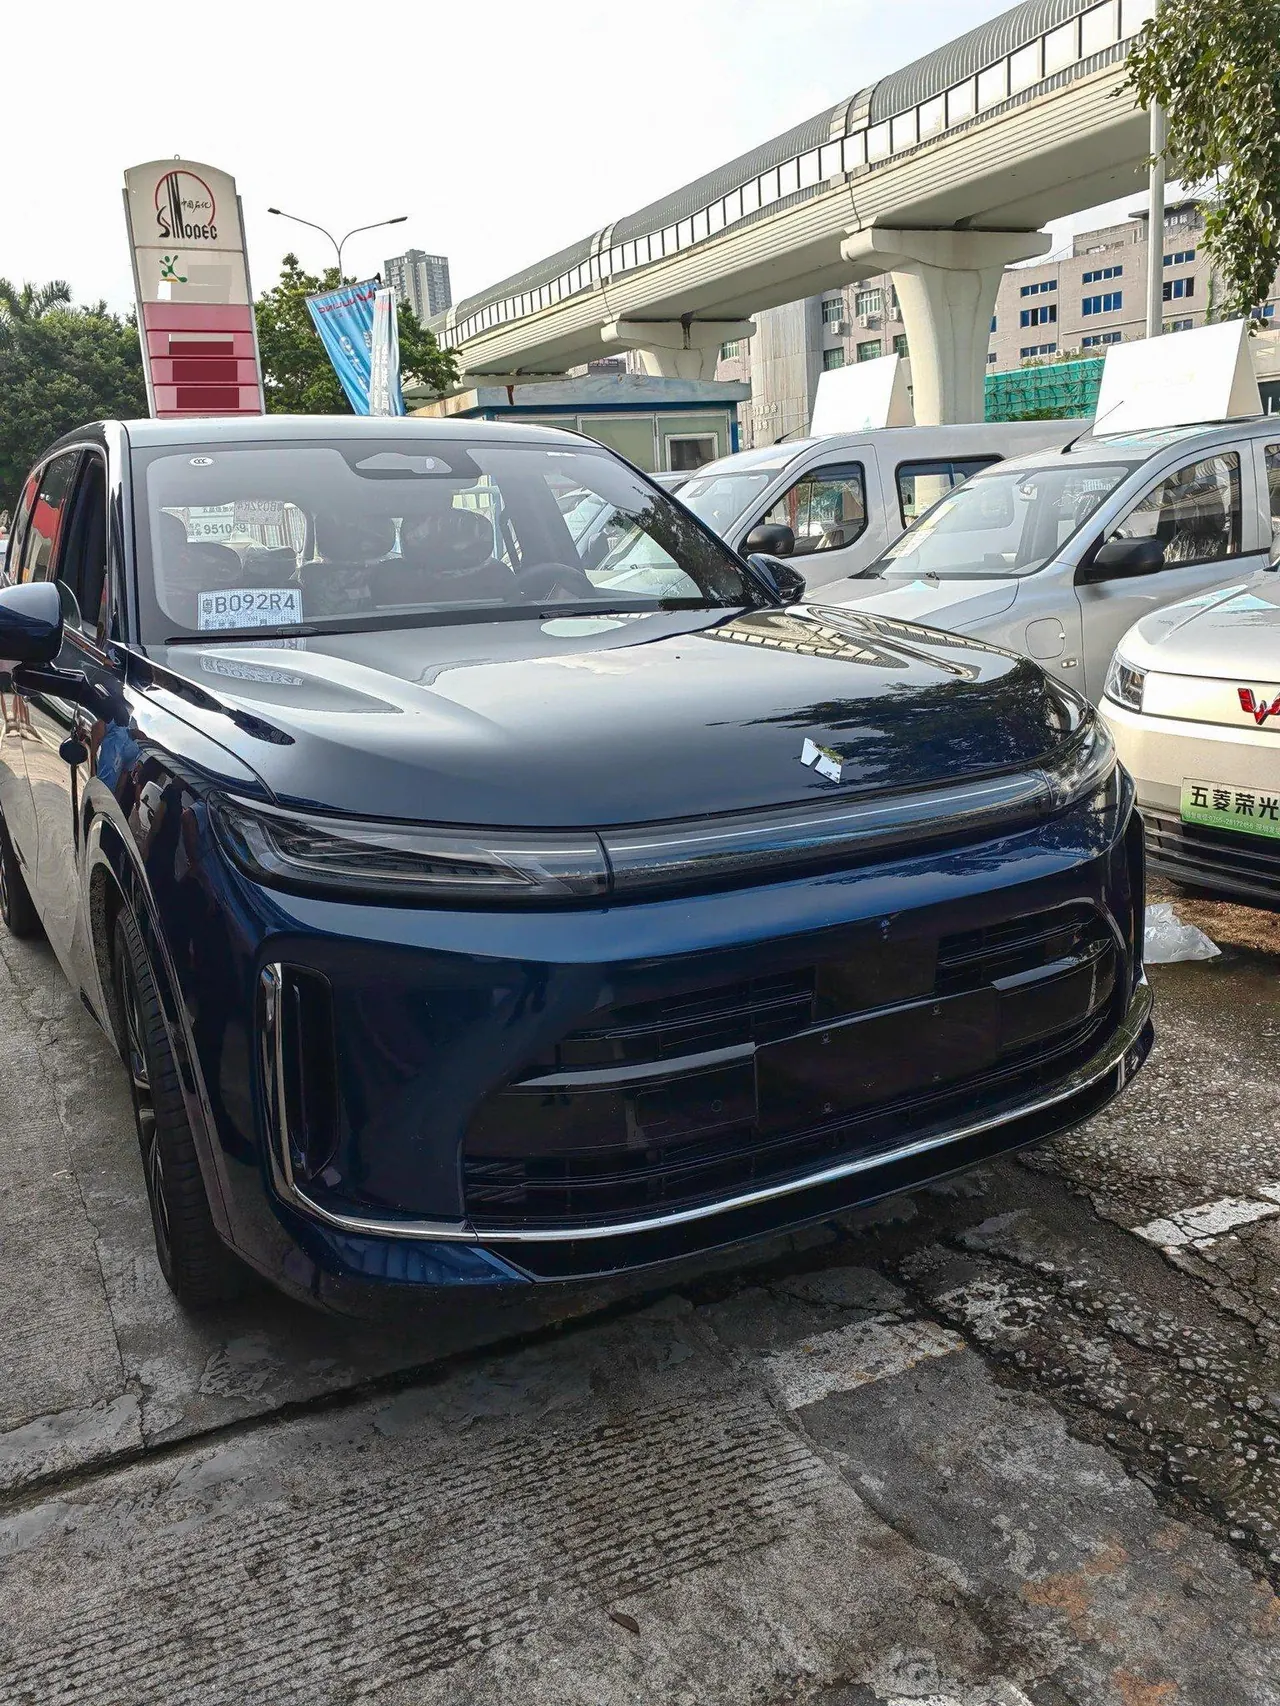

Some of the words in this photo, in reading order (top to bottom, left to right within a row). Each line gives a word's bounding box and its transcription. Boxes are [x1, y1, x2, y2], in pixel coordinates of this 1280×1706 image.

[181, 198, 212, 214] 中国石化
[1190, 785, 1279, 821] 五菱荣光
